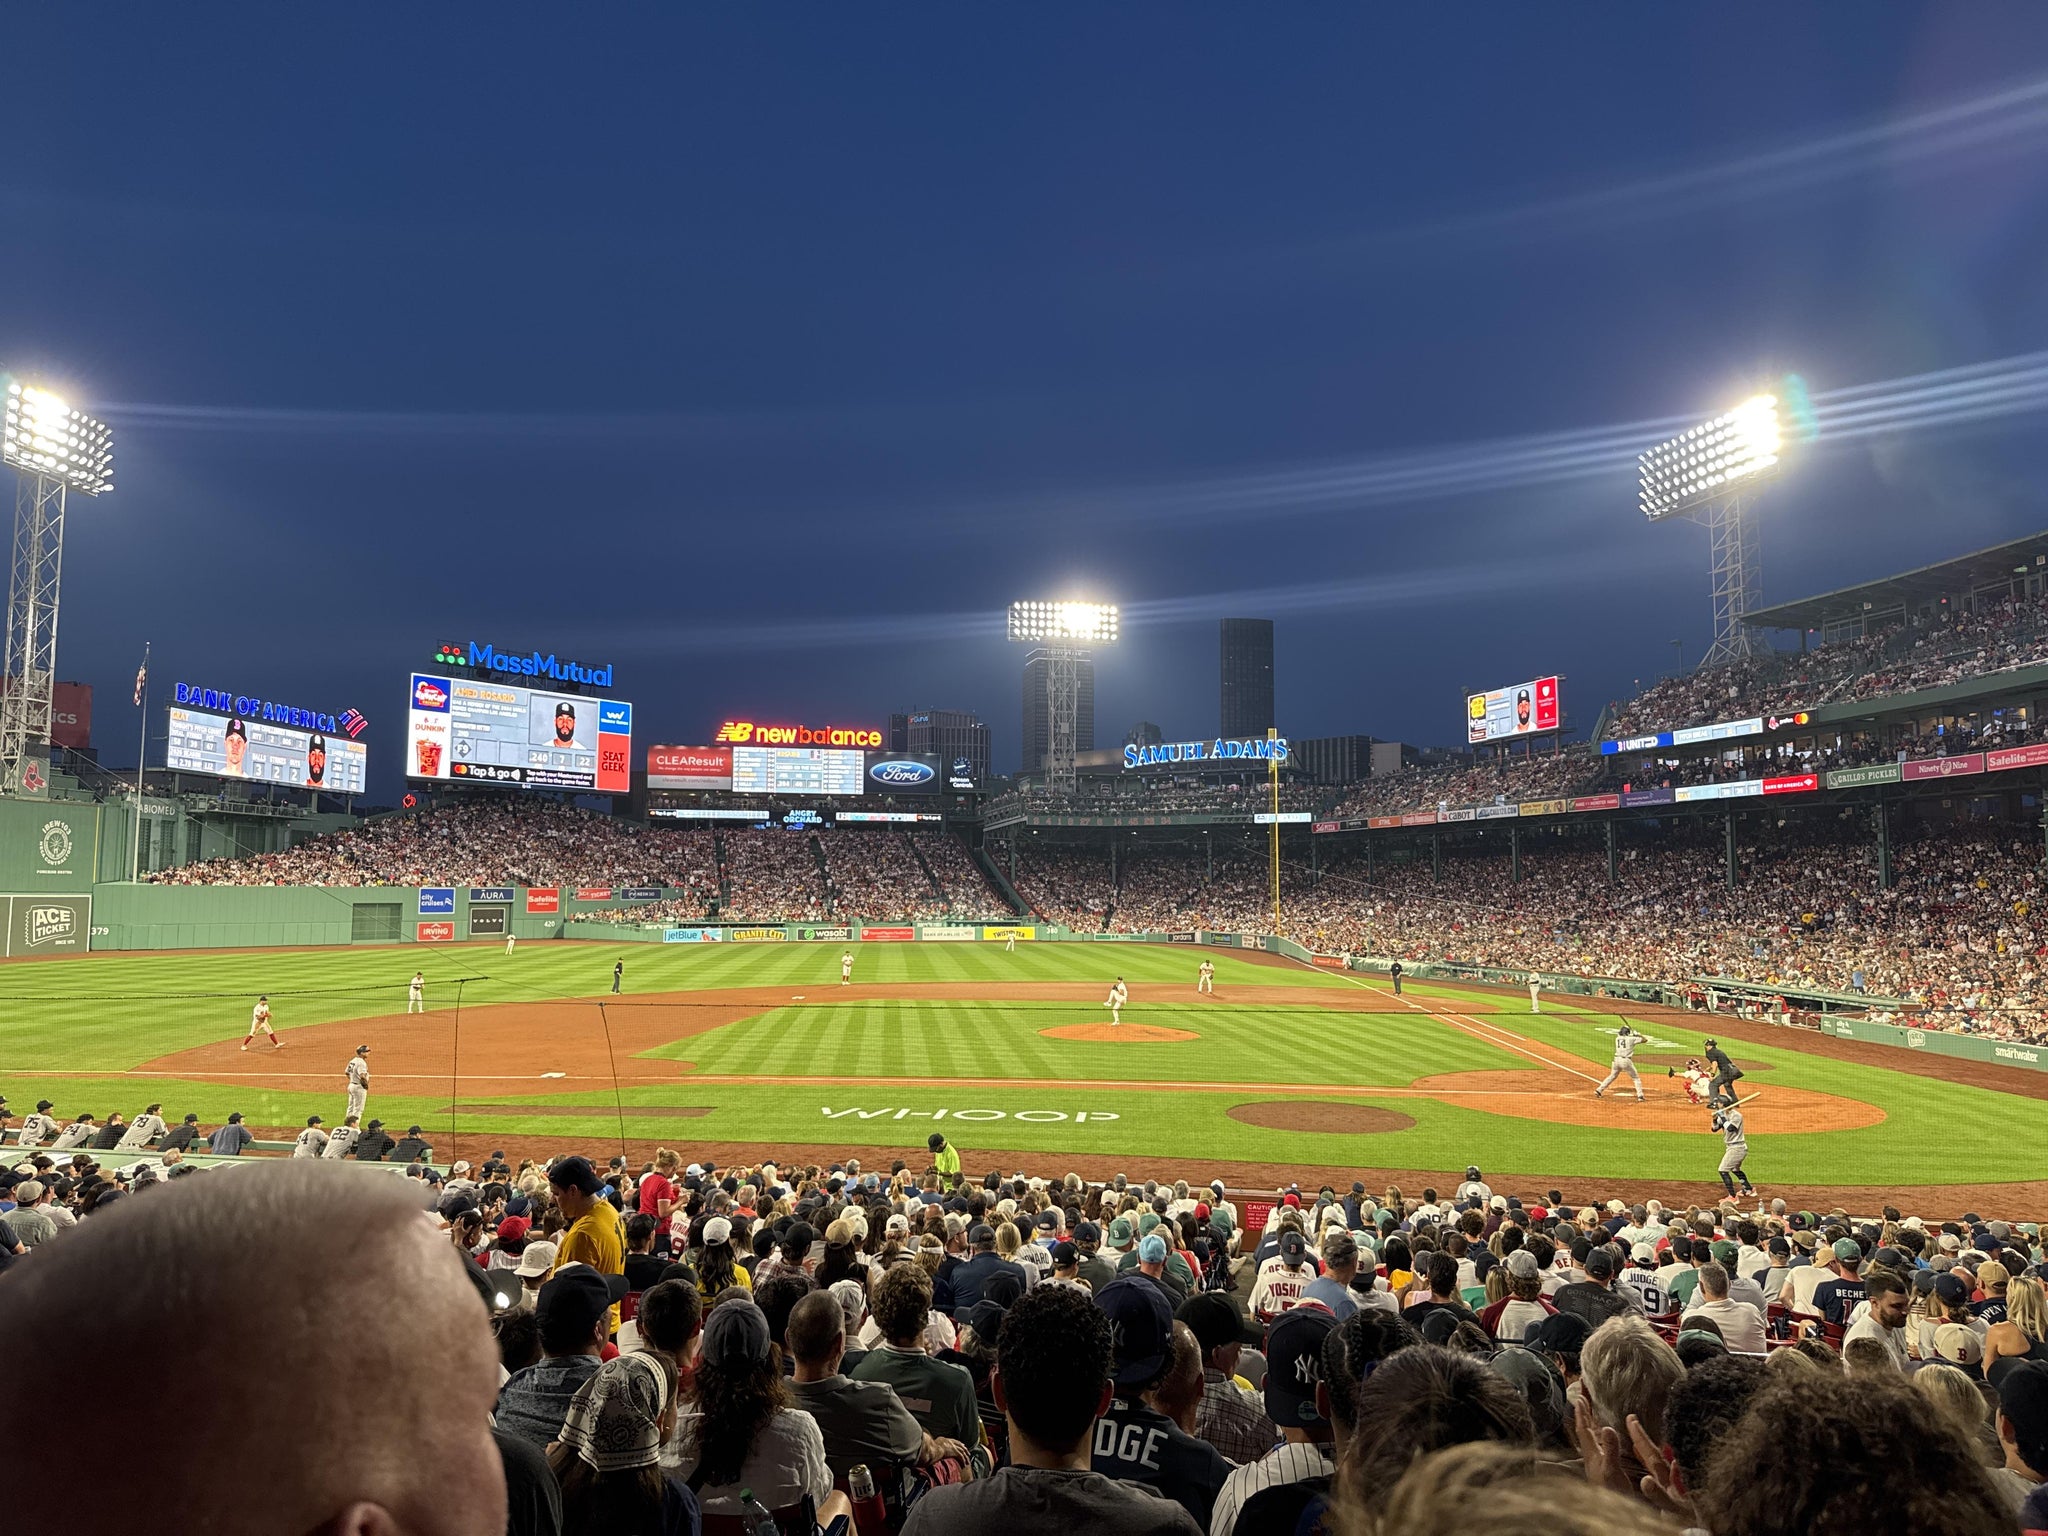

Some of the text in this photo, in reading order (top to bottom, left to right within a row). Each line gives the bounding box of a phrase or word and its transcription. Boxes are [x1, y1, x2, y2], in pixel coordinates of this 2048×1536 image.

[469, 641, 613, 687] MassMutual
[480, 690, 516, 703] ROSARIO
[175, 682, 232, 712] BANK
[235, 696, 260, 717] OF
[263, 701, 336, 733] AMERICA
[415, 723, 446, 733] DUNKIN'
[756, 726, 797, 744] new
[799, 725, 882, 747] balance
[457, 745, 469, 754] F9
[1626, 737, 1658, 751] UNITED
[529, 752, 548, 763] .240
[580, 757, 590, 766] 22
[603, 750, 624, 762] SEAT
[1124, 737, 1288, 768] SAMUEL ADAMS
[657, 755, 723, 766] CLEAResult
[1989, 754, 2027, 766] Safelite
[255, 765, 297, 779] 3 2 2
[469, 765, 510, 780] Tap & go
[602, 761, 624, 773] GEEK
[882, 763, 922, 782] Ford
[1918, 765, 1940, 774] Ninety
[1952, 761, 1968, 770] Nine
[1838, 768, 1897, 783] GRILLO'S PICKLES
[139, 803, 176, 816] ABIOMED
[783, 816, 823, 824] ORCHARD
[42, 820, 72, 835] IBEW 103
[590, 890, 611, 898] TICKET
[35, 908, 71, 926] ACE
[35, 923, 71, 938] TICKET
[91, 927, 109, 935] 379
[423, 927, 448, 935] IRVING
[668, 930, 697, 941] jetBlue
[734, 929, 786, 940] GRANITE CITY
[816, 929, 847, 937] wasabi
[1617, 1039, 1626, 1048] 14
[1995, 1047, 2038, 1062] smartwater
[821, 1107, 1120, 1123] WHOOP
[24, 1117, 40, 1129] 75
[131, 1116, 149, 1128] 78
[63, 1125, 81, 1136] 24
[331, 1128, 350, 1140] 22
[1113, 1230, 1120, 1238] B
[1290, 1244, 1297, 1254] B
[1628, 1272, 1659, 1286] JUDGE
[1268, 1282, 1302, 1298] YOSHI
[1632, 1286, 1659, 1313] 9
[1842, 1299, 1859, 1324] 1
[1957, 1347, 1967, 1361] B
[1294, 1353, 1319, 1384] NY
[1094, 1418, 1169, 1471] DGE
